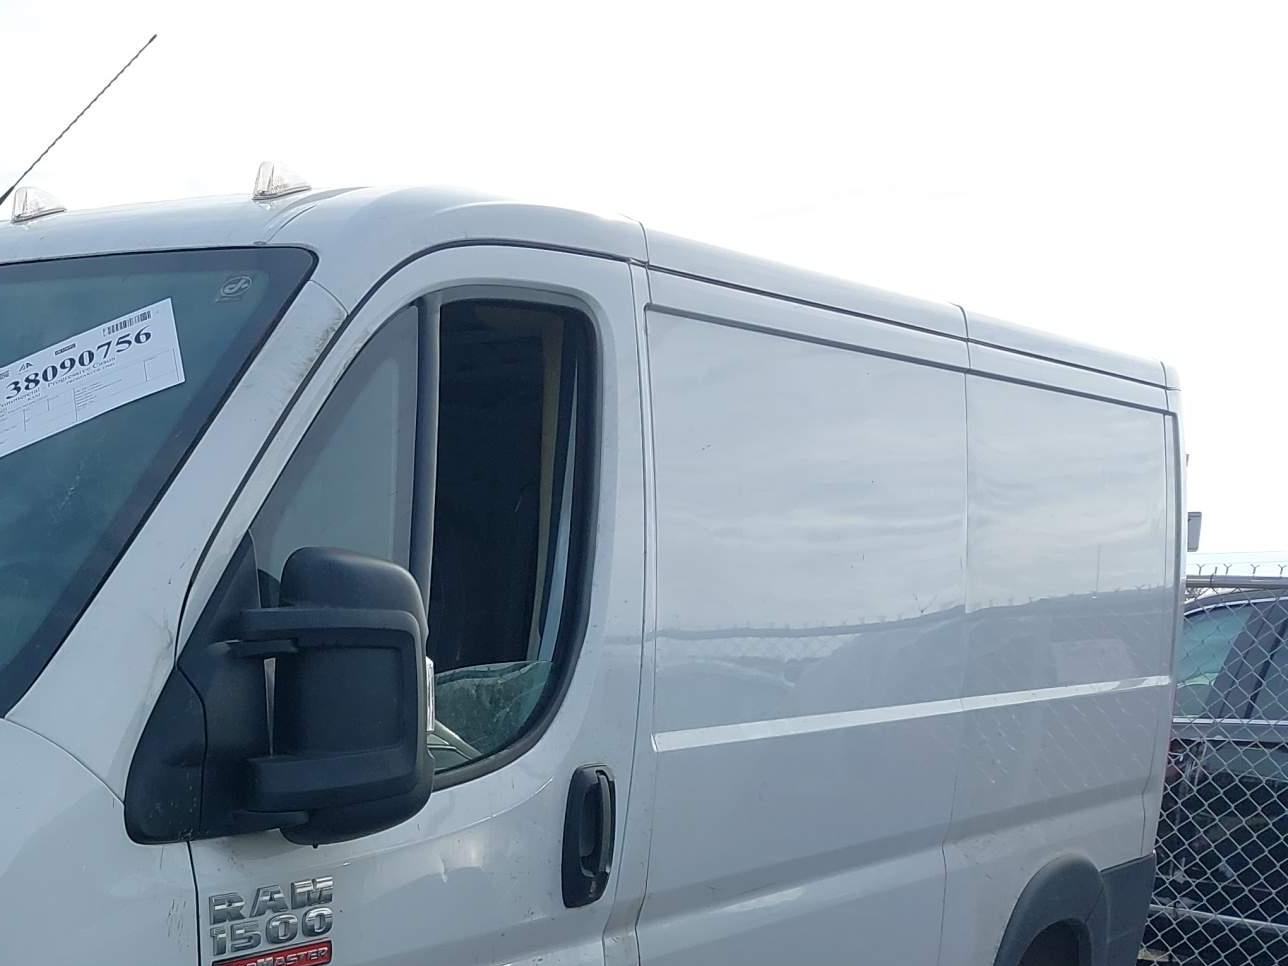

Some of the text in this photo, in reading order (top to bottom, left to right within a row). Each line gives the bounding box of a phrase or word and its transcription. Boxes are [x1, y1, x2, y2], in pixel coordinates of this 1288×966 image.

[5, 325, 152, 399] 38090756
[208, 876, 333, 926] RAM
[209, 906, 333, 957] 1500
